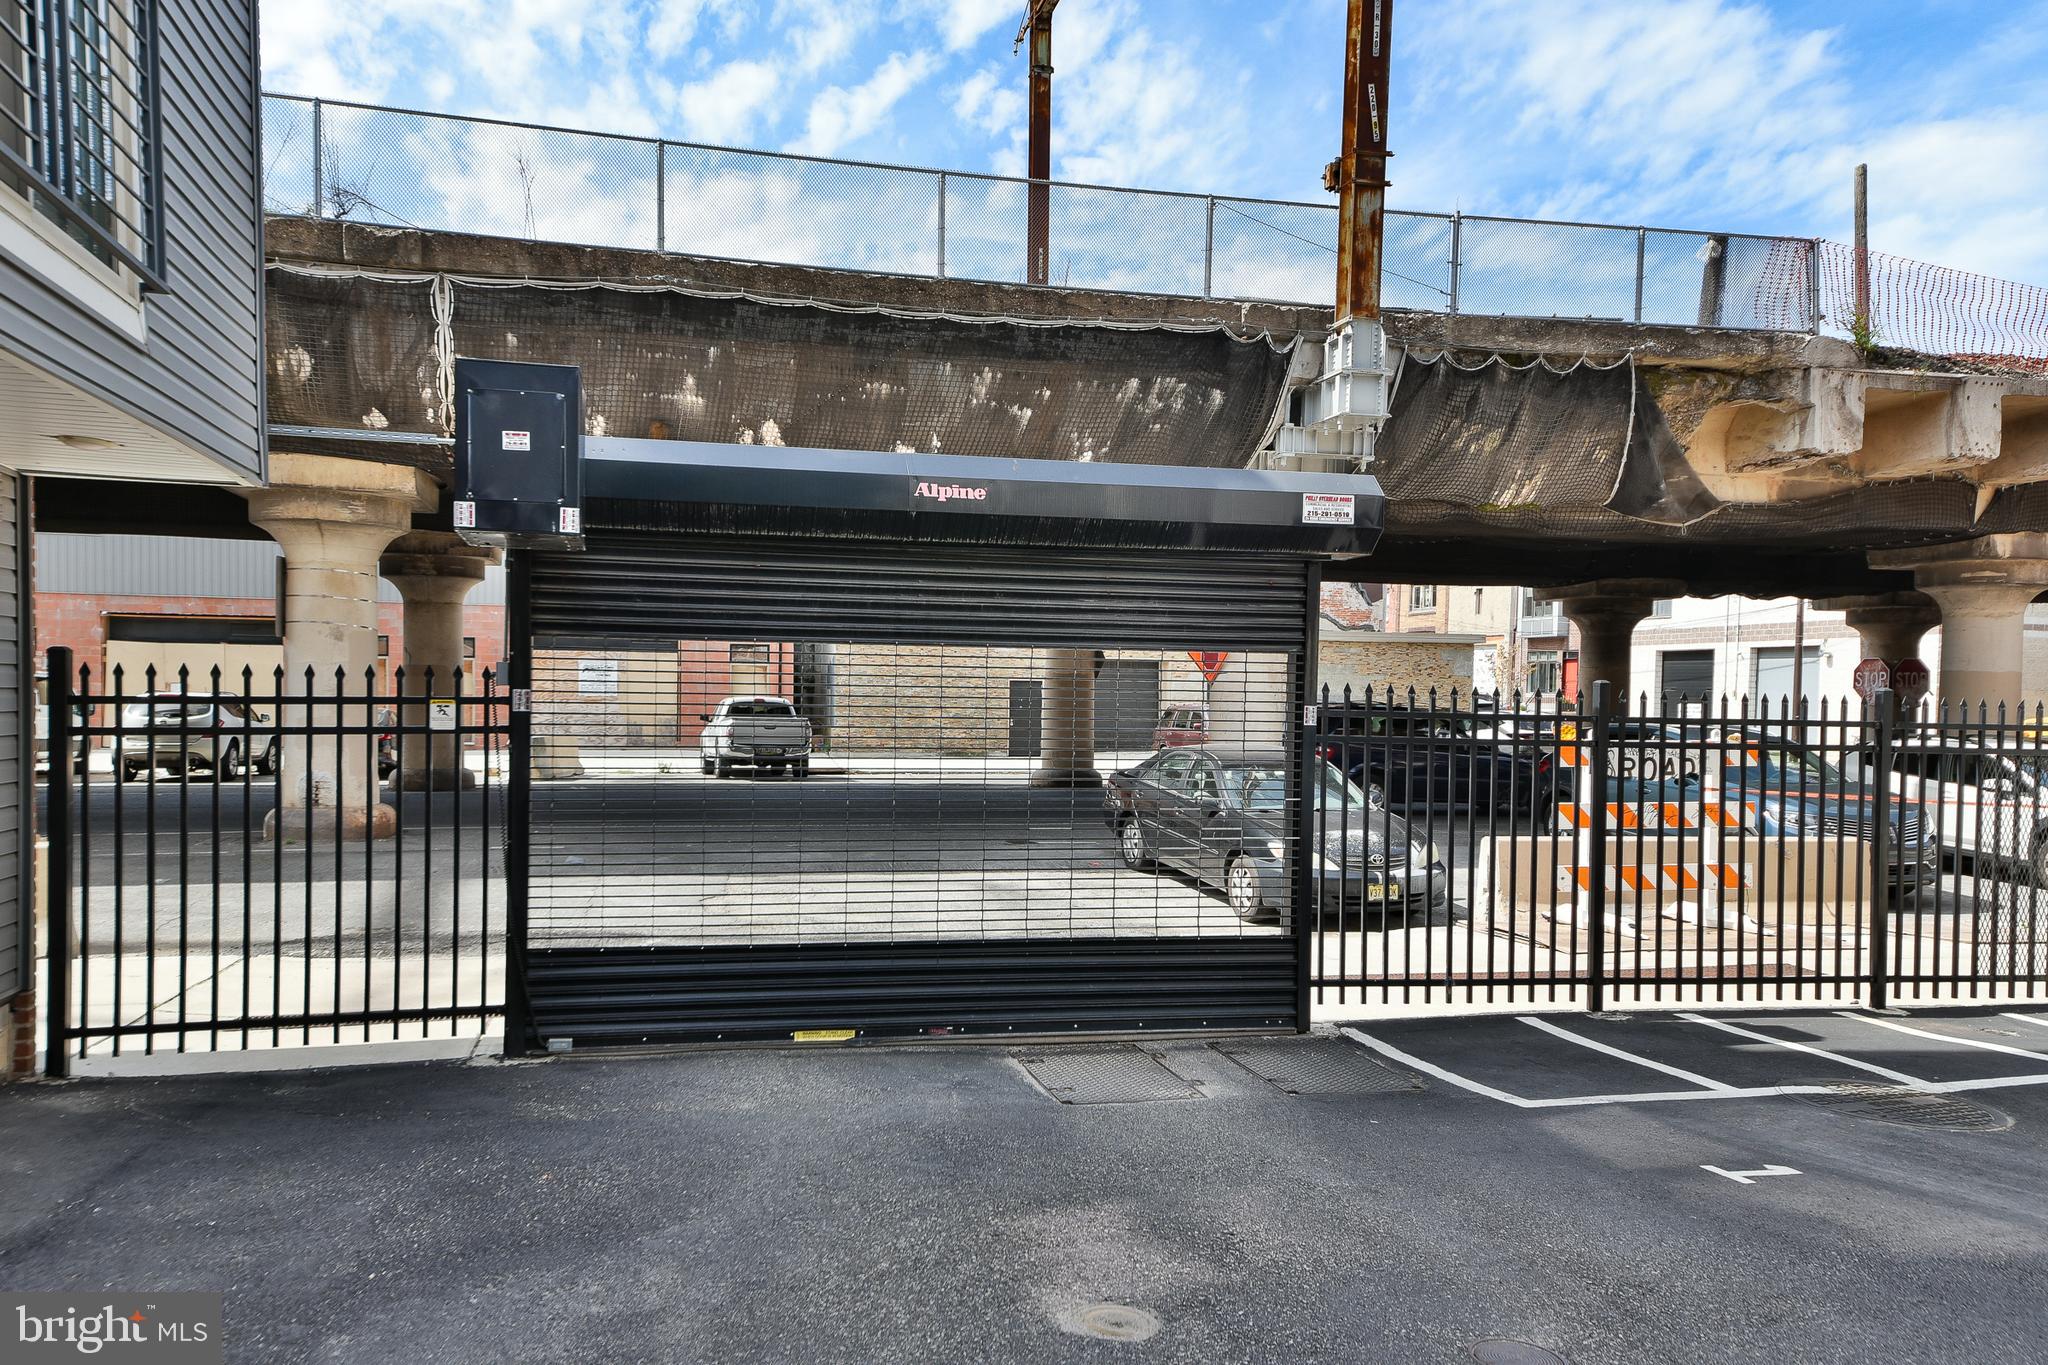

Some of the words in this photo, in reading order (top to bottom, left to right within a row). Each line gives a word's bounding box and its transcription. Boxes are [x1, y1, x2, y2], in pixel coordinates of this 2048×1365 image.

[913, 482, 987, 502] Alpine
[1855, 671, 1887, 688] STOP
[1896, 671, 1928, 688] STOP
[1620, 757, 1697, 781] ROAD
